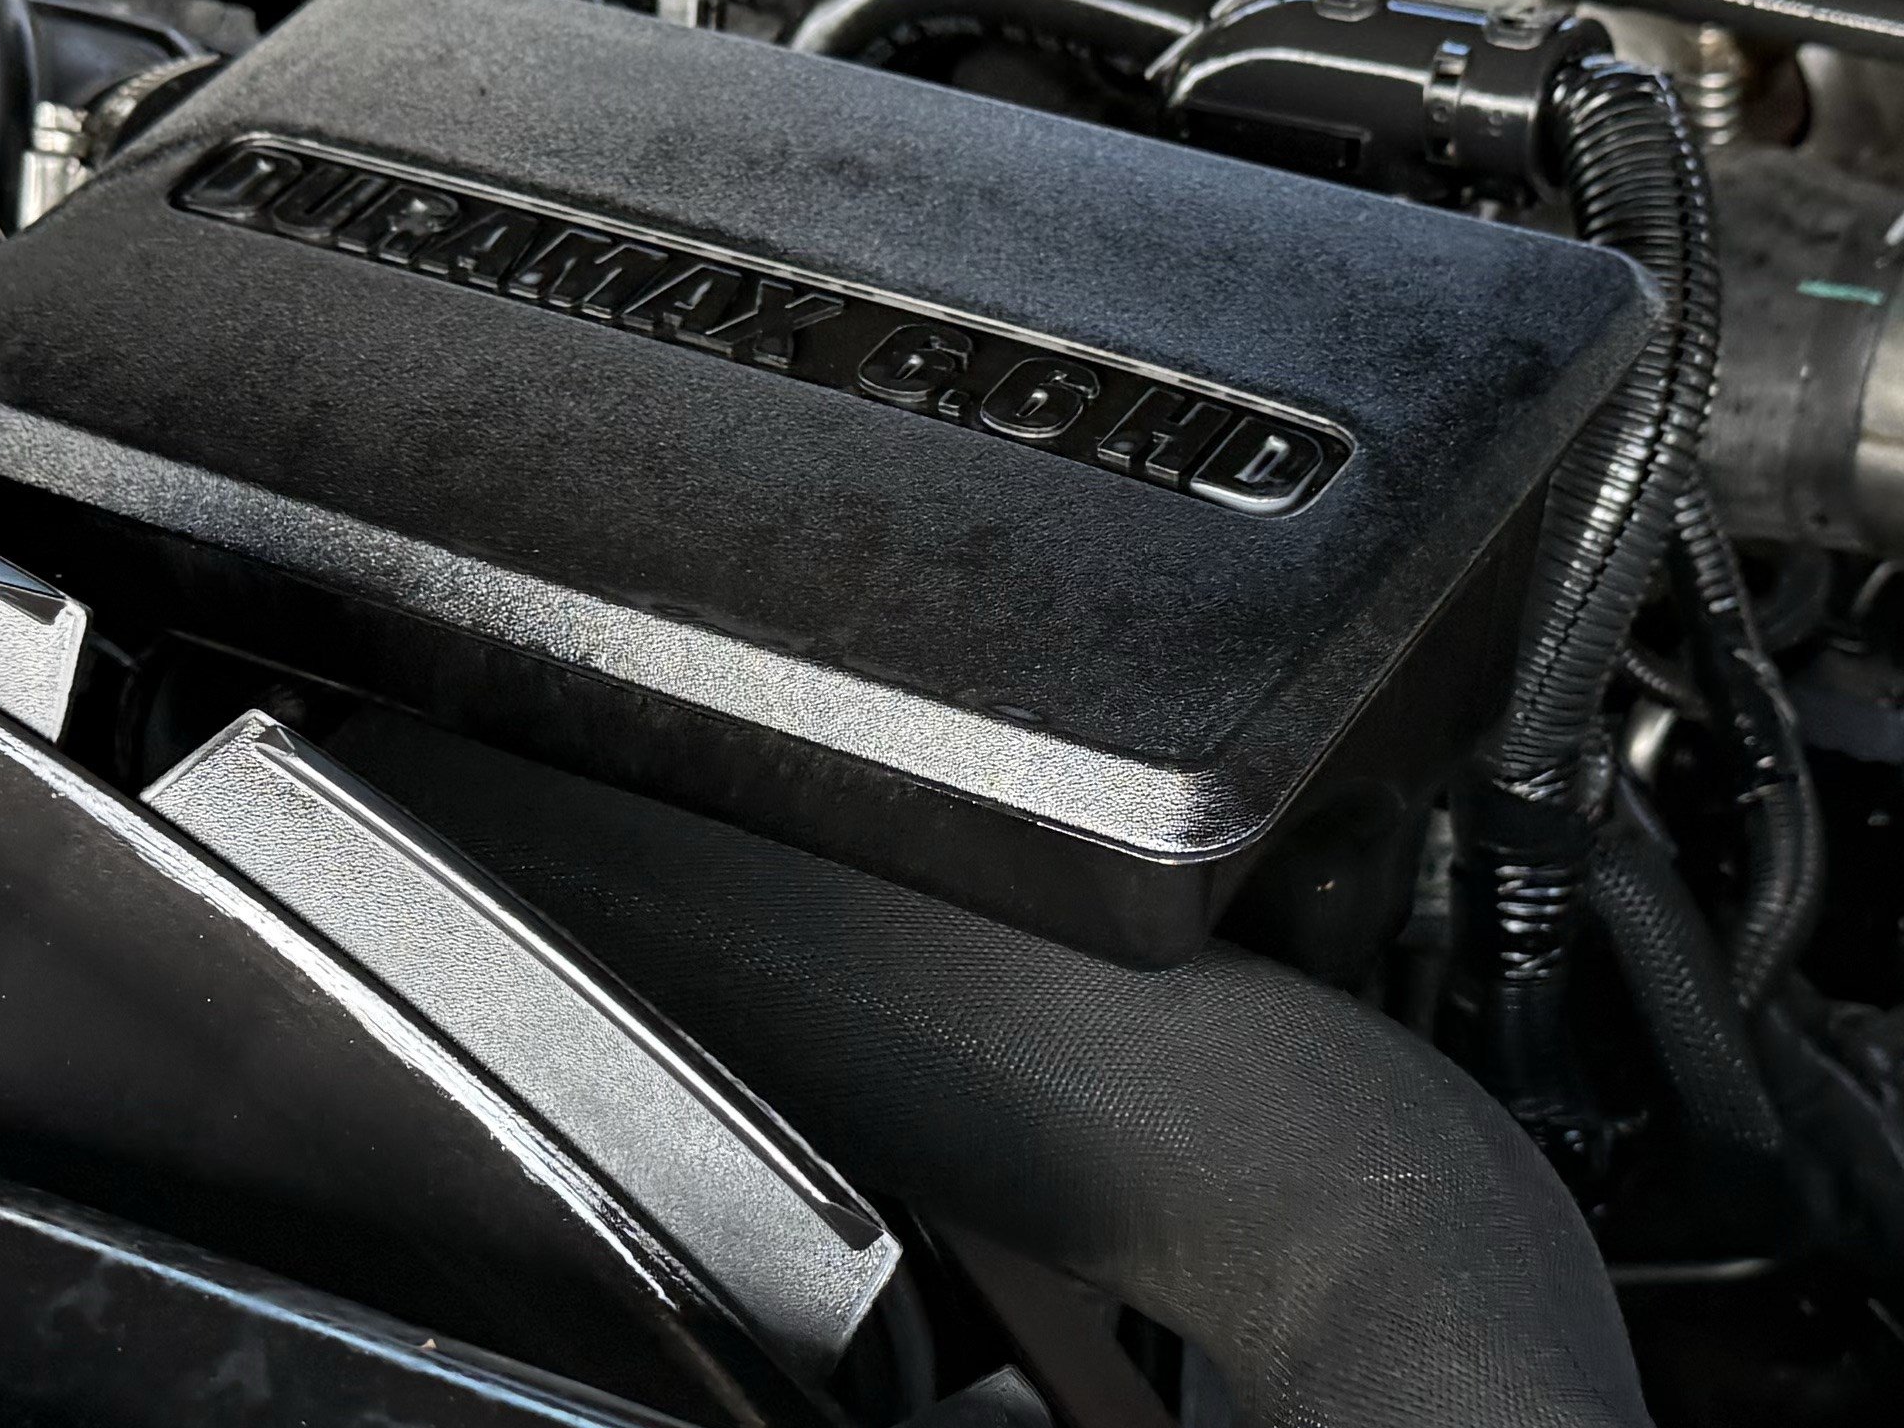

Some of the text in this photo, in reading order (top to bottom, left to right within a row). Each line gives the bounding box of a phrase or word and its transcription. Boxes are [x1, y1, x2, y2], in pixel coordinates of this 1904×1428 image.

[176, 145, 1324, 516] DURAMAX 6.6 HD
